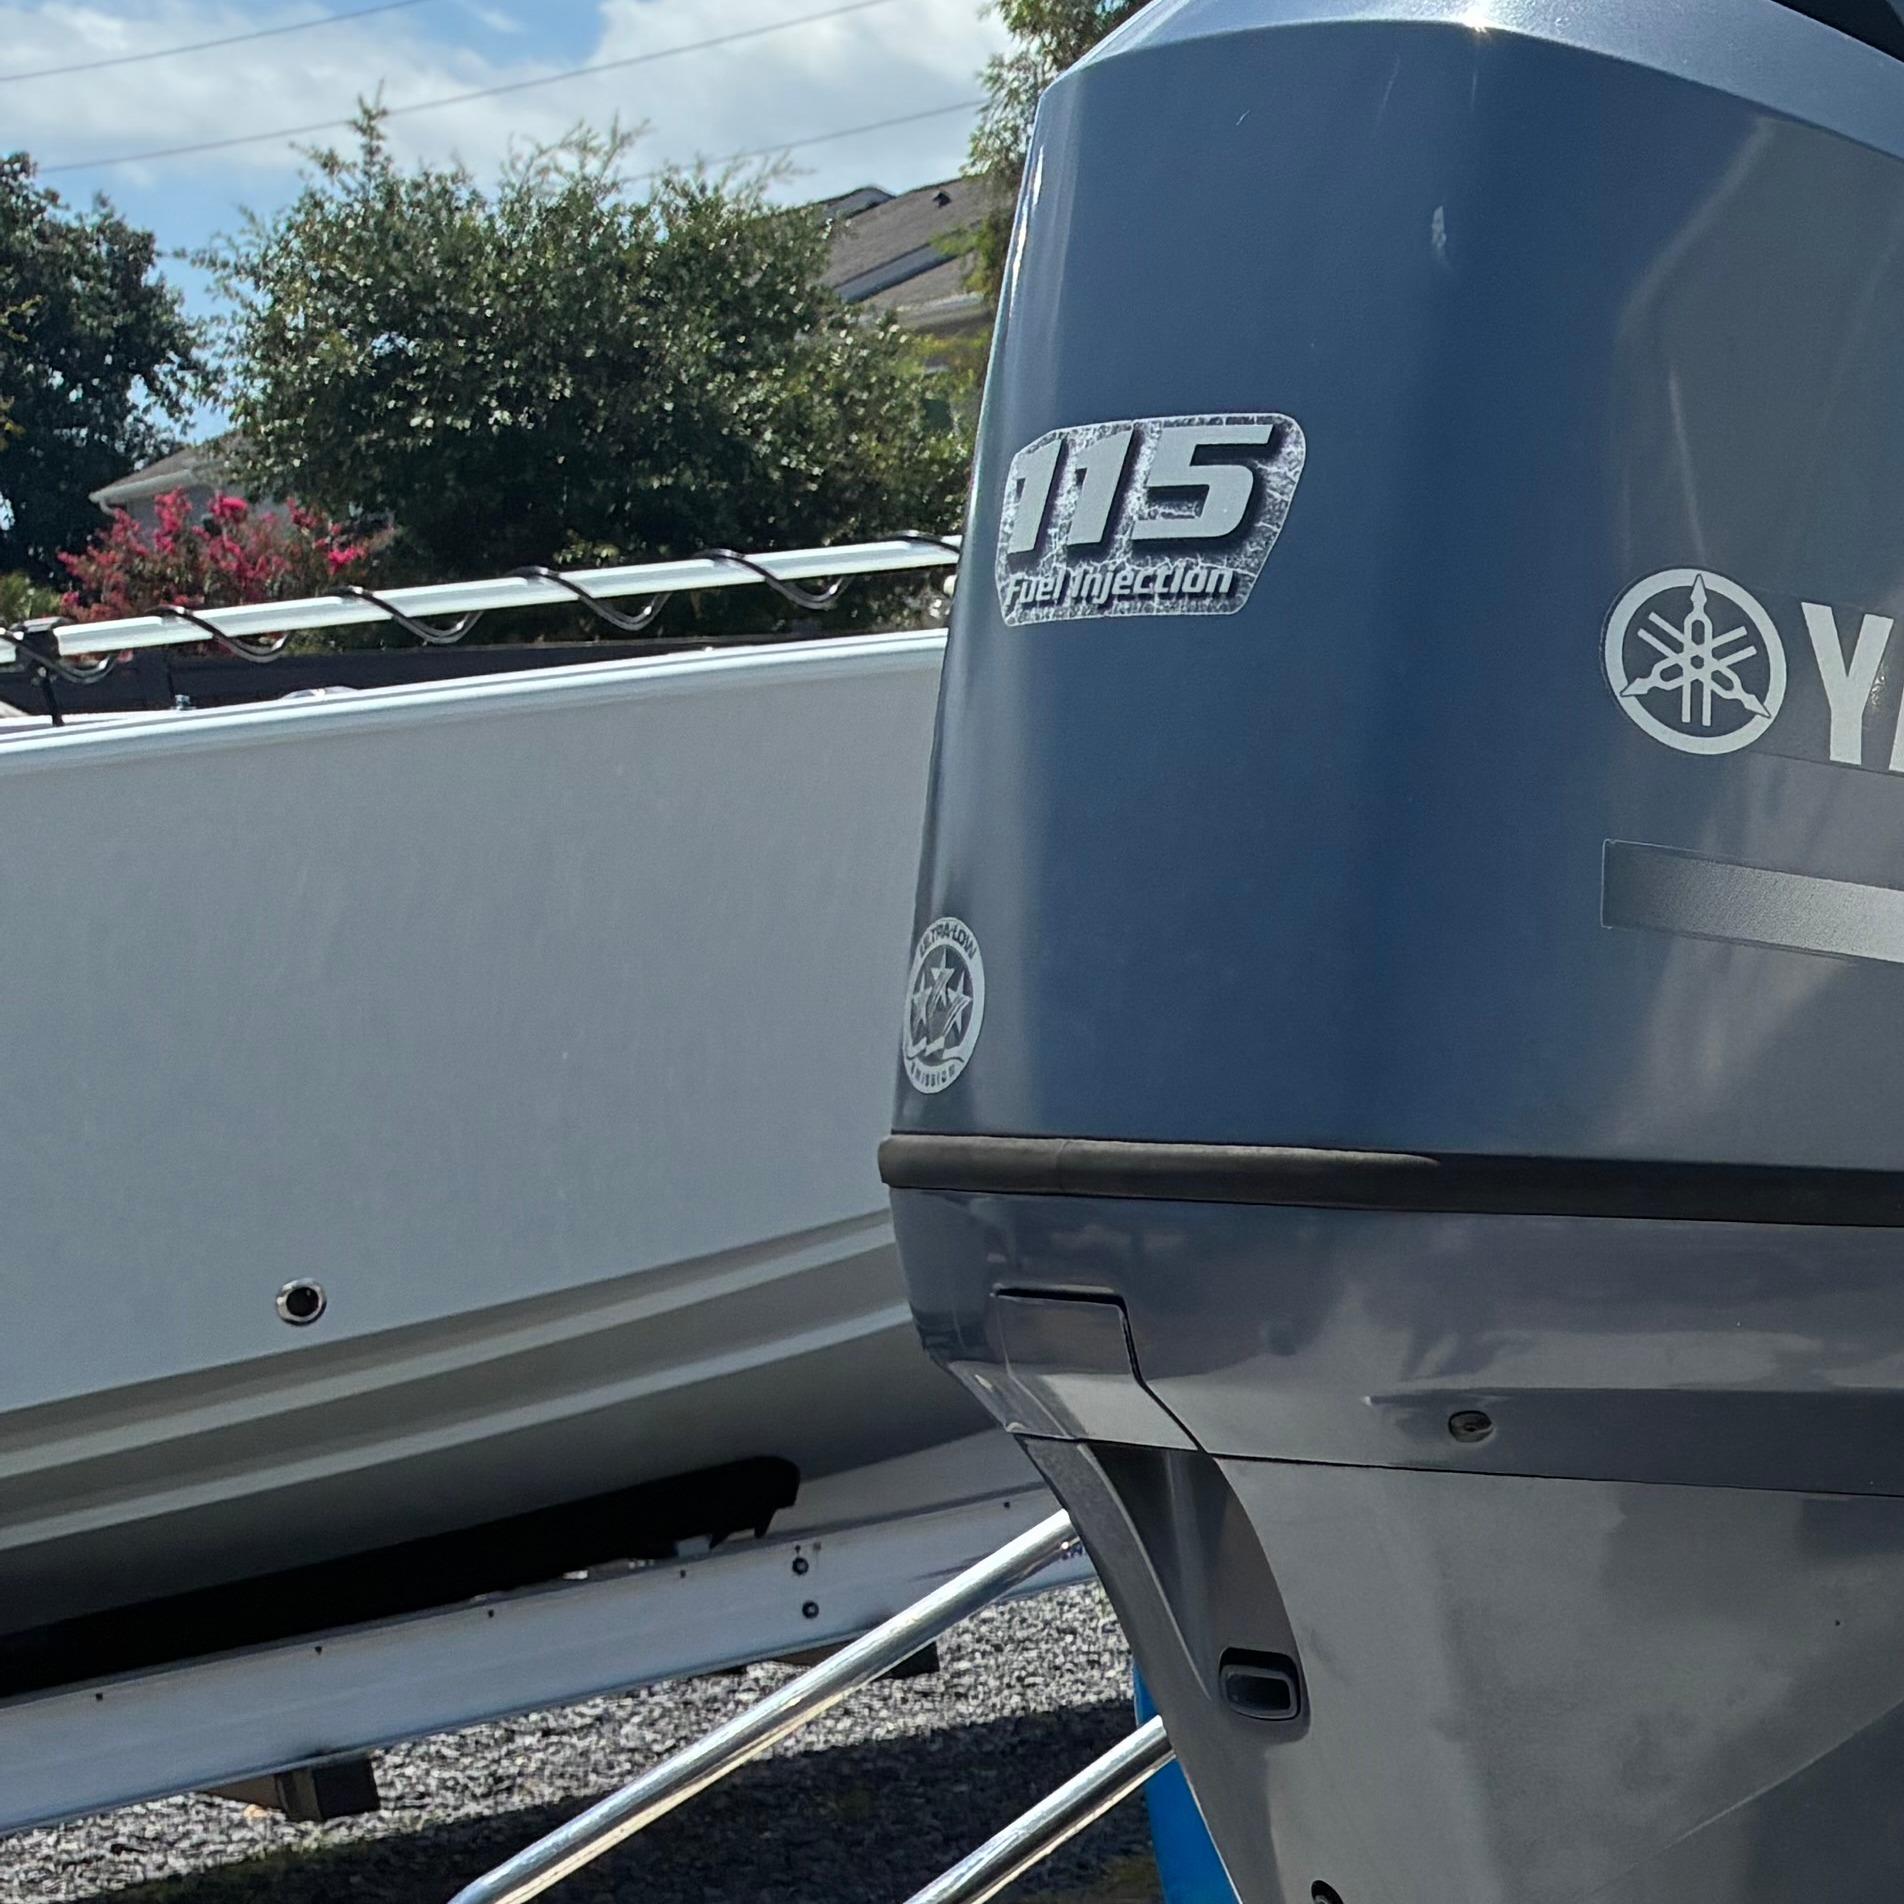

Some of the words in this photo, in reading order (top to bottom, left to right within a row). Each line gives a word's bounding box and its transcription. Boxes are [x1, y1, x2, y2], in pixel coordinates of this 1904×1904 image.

[1007, 424, 1274, 554] 115
[1005, 565, 1066, 604] Fuel
[1070, 563, 1234, 604] Injection
